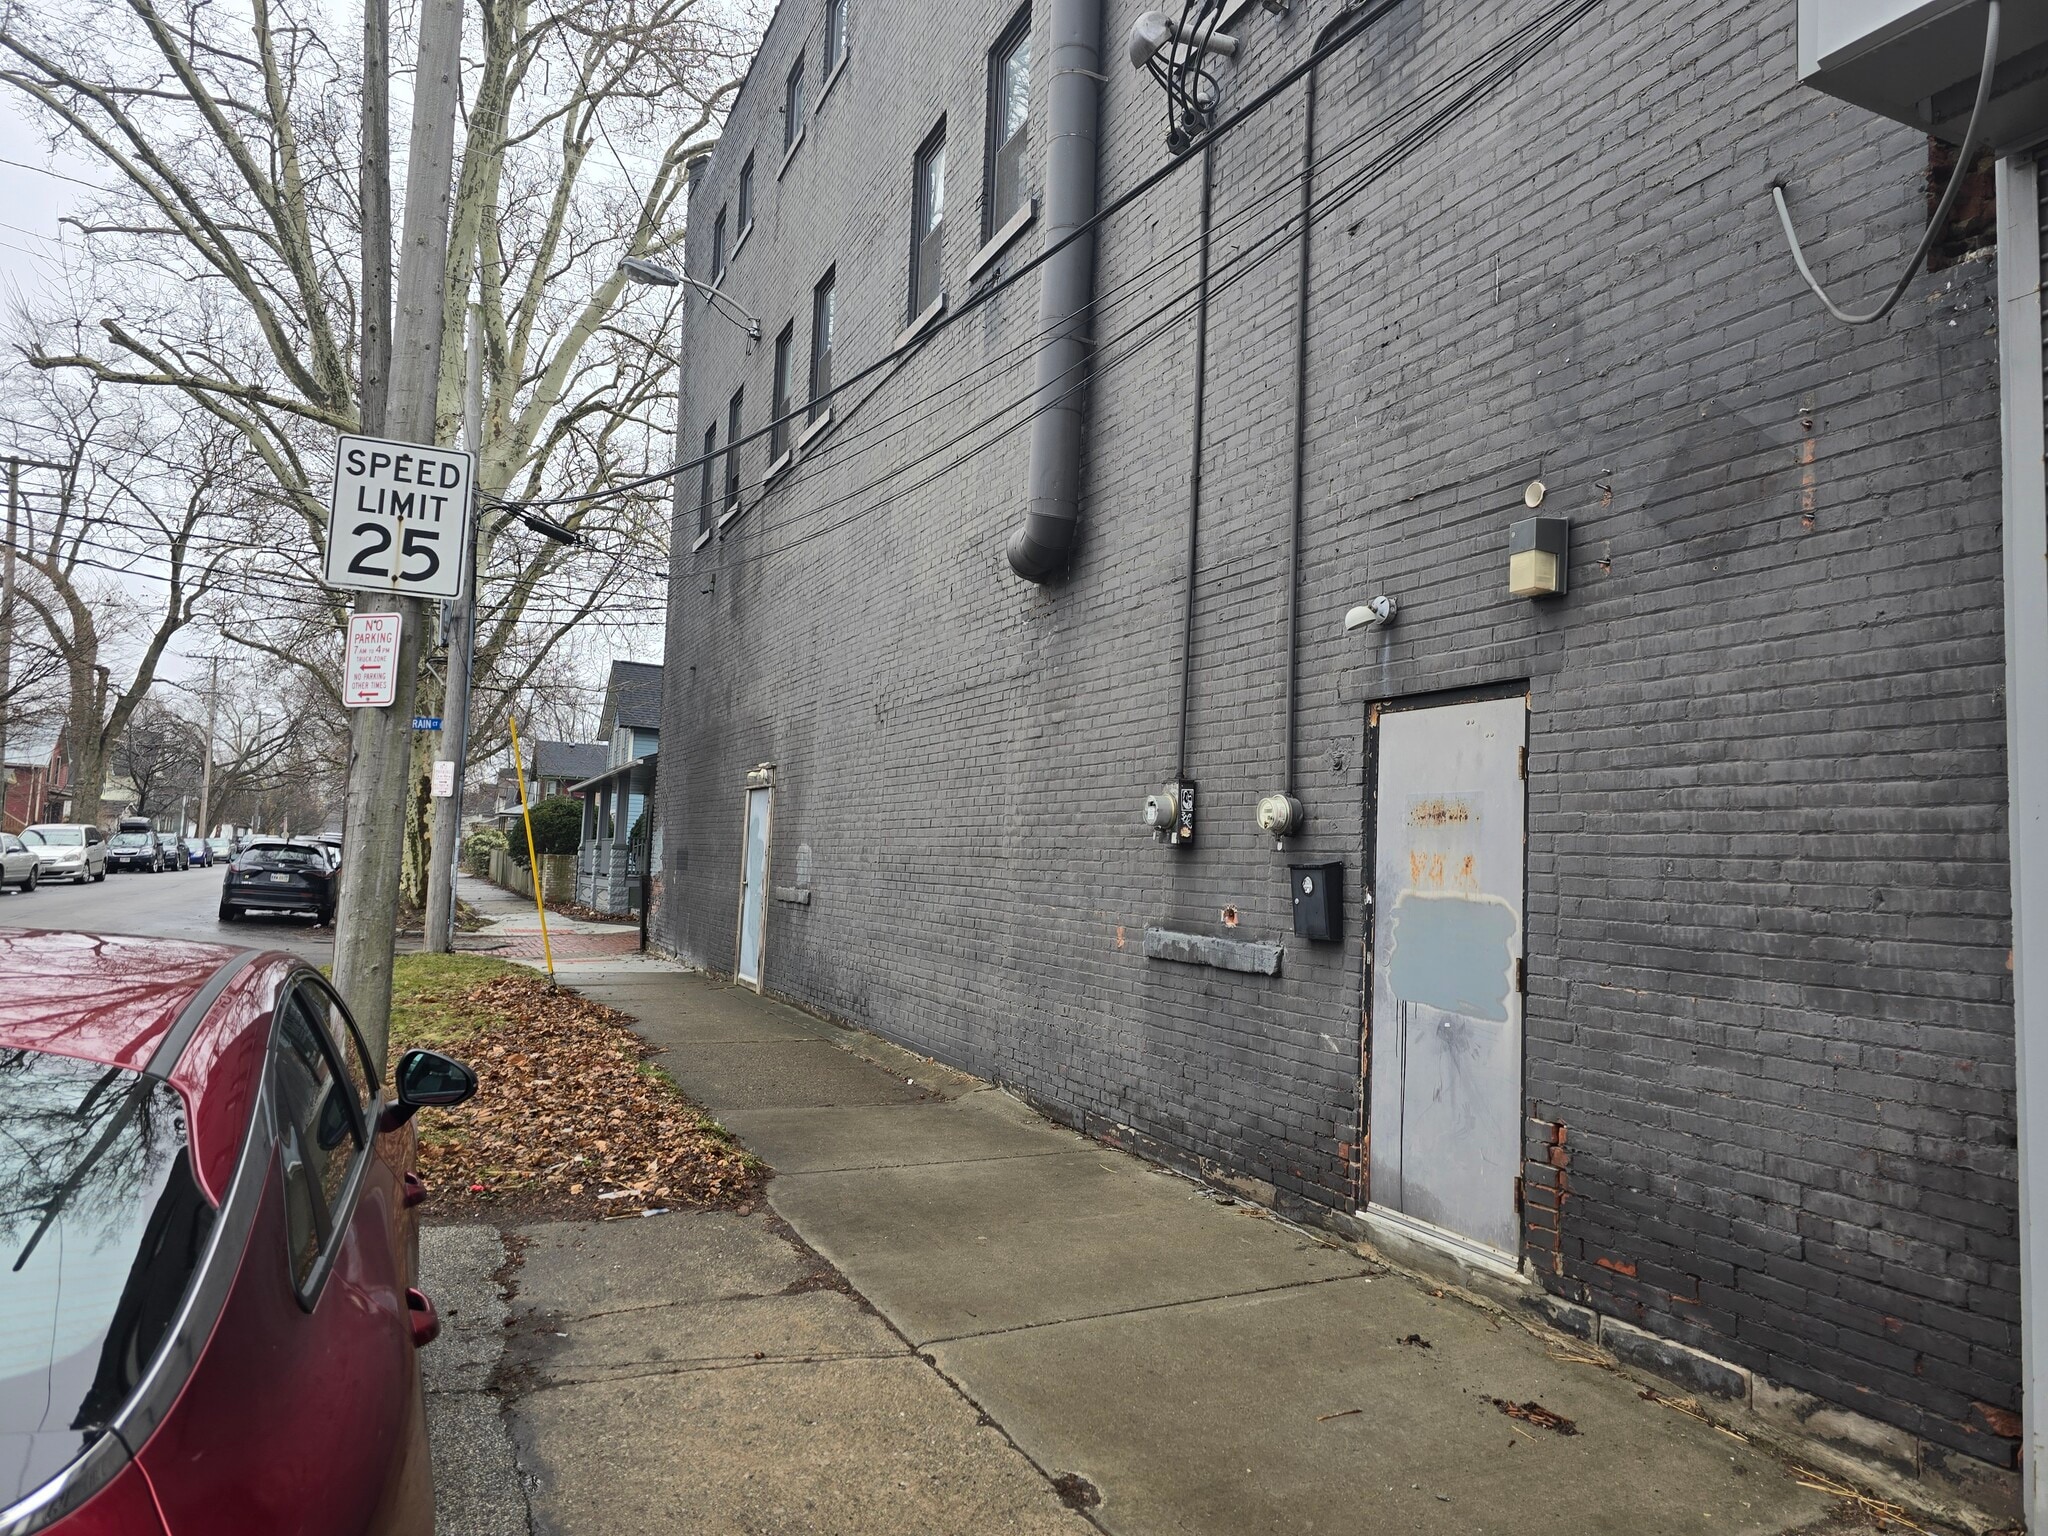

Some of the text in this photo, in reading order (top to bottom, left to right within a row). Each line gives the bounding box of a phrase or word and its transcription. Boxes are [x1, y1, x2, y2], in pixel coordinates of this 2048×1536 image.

[345, 449, 460, 489] SPEED
[357, 485, 448, 522] LIMIT
[347, 522, 440, 582] 25
[365, 619, 383, 631] NO
[354, 632, 392, 644] PARKING
[354, 645, 359, 655] 7
[375, 645, 381, 653] 4
[363, 672, 386, 680] PARKING
[351, 681, 387, 690] OTHER TIMES
